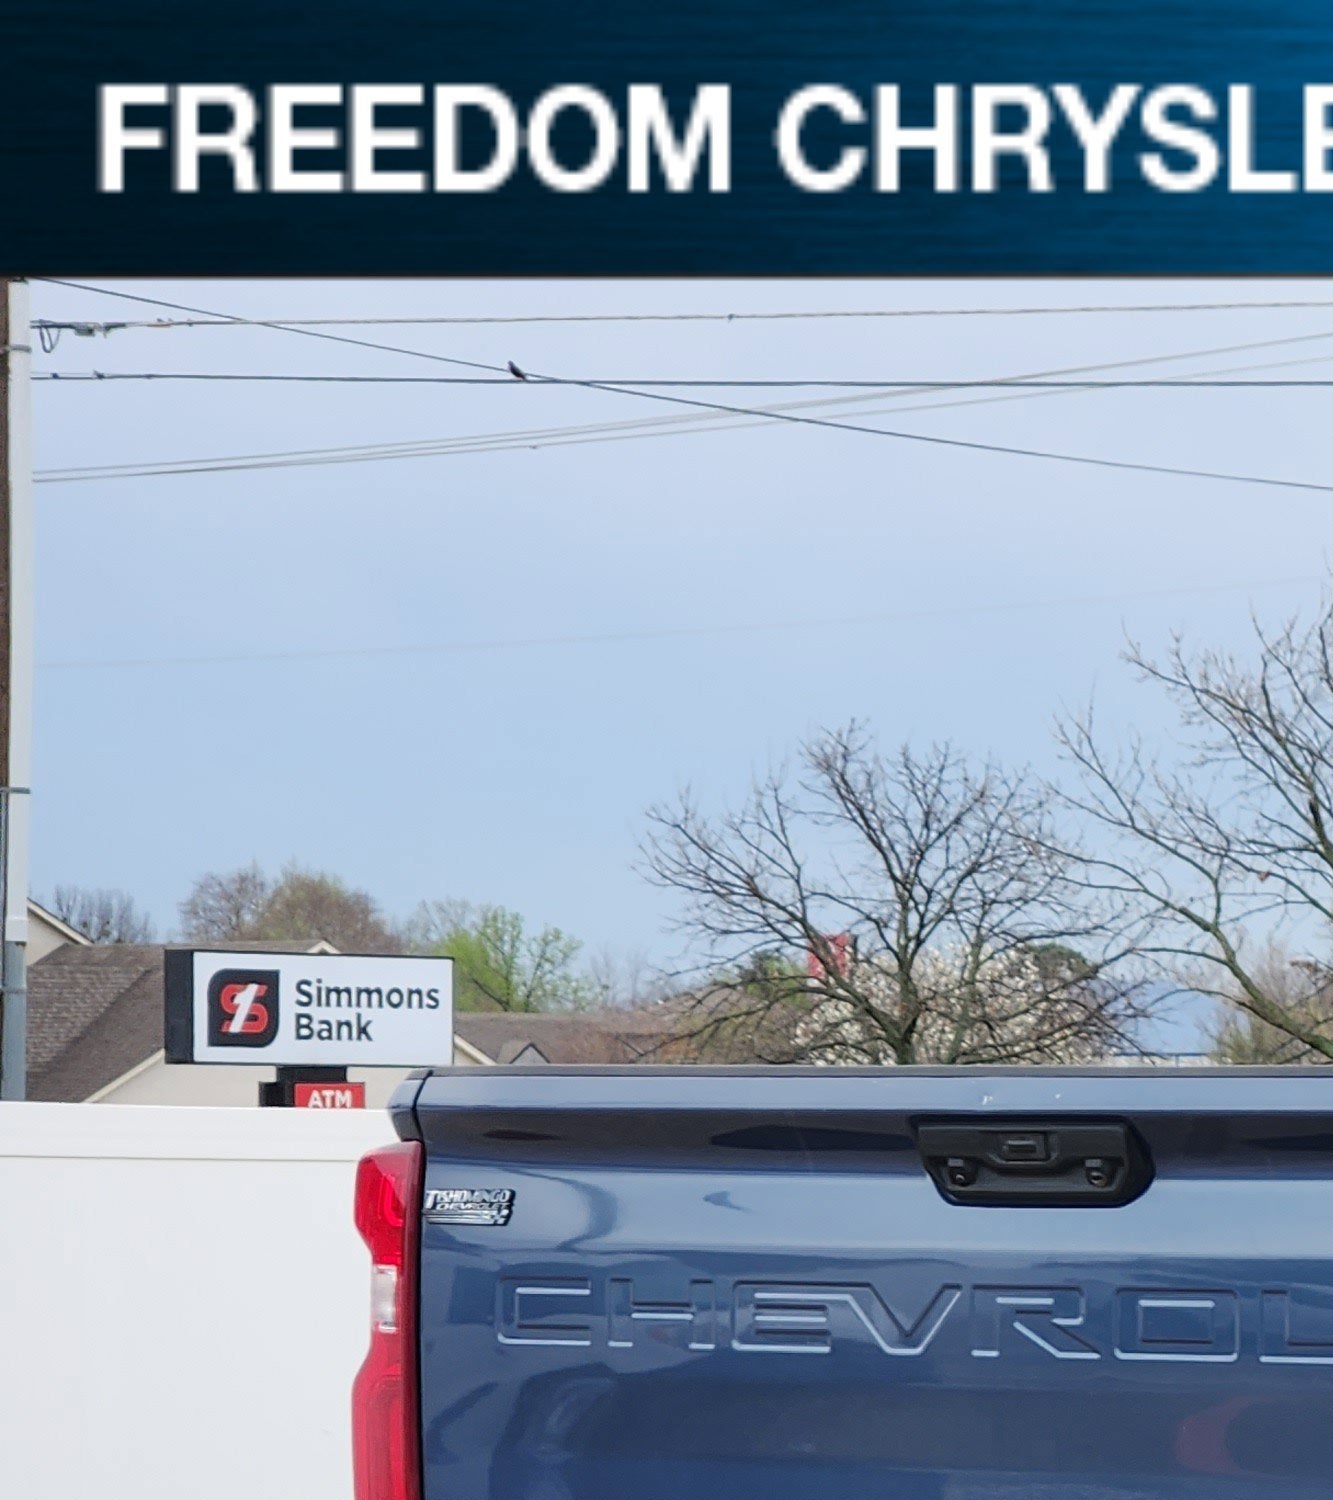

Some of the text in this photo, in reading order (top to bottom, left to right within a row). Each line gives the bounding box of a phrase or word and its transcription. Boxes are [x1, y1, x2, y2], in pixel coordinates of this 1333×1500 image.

[295, 978, 440, 1010] Simmons
[295, 1012, 373, 1042] Bank
[307, 1089, 352, 1108] ATM
